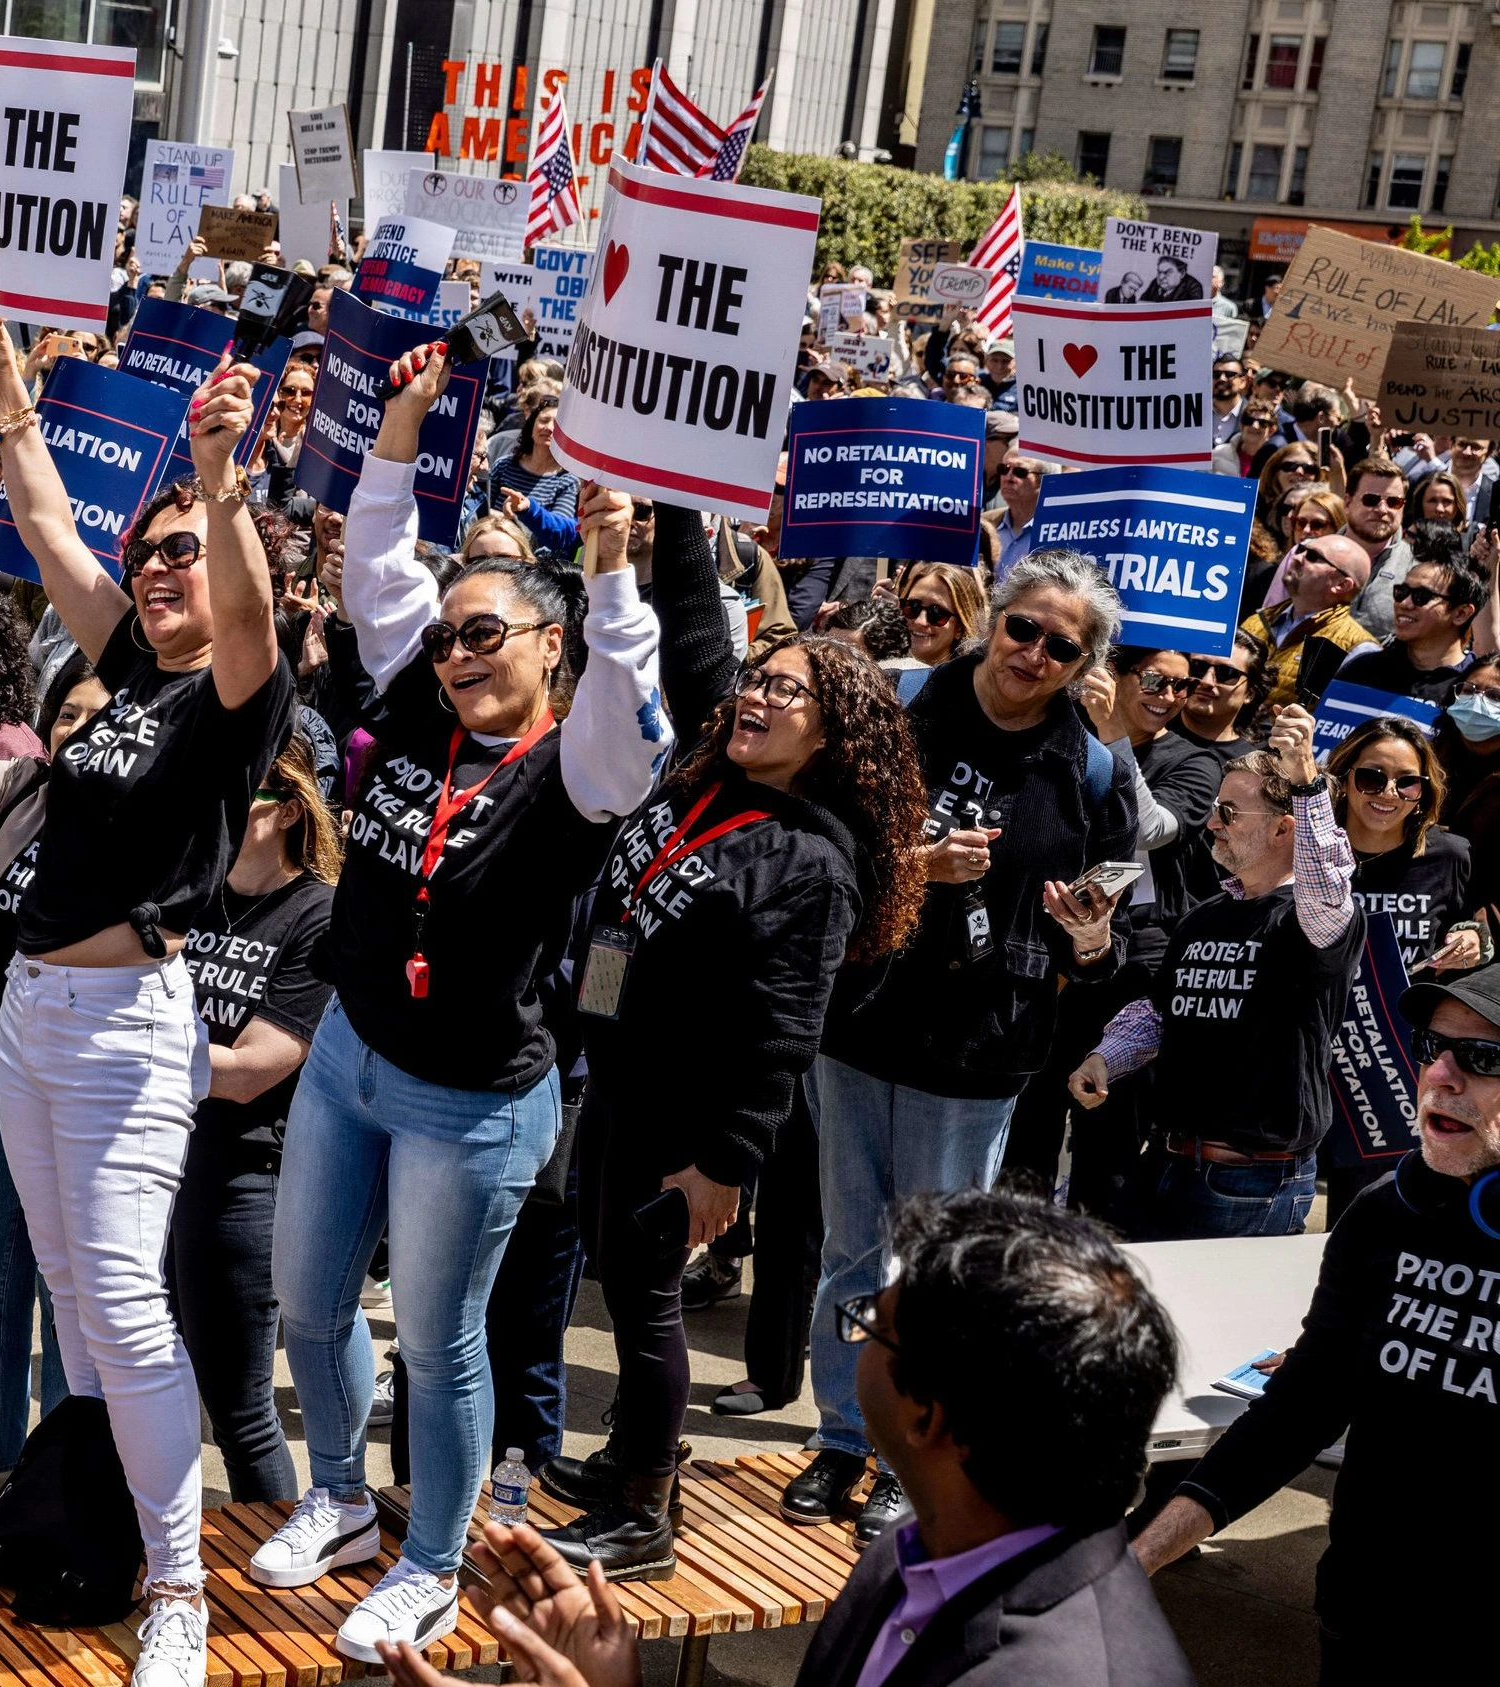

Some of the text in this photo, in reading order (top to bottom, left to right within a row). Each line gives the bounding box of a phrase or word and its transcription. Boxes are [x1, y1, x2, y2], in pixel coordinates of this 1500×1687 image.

[442, 59, 651, 113] THIS IS
[4, 107, 80, 173] THE
[424, 112, 644, 165] AMEICA
[157, 145, 224, 167] STAND UP
[150, 182, 214, 208] RULE
[454, 179, 485, 200] OUR
[166, 208, 186, 225] OF
[211, 209, 273, 227] MAKE AMERICA
[150, 222, 195, 245] LA
[374, 224, 406, 241] DEFEND
[1116, 222, 1202, 246] DON'T BEND
[219, 246, 246, 257] AGAIN
[373, 241, 418, 264] JUSTICE
[536, 248, 587, 274] GOVT
[908, 243, 950, 264] SEE
[1120, 237, 1195, 260] THE KNEE!
[360, 259, 388, 275] DEFEND
[1034, 255, 1101, 275] Make Lyi
[360, 276, 426, 305] DEMOCRACY
[656, 253, 748, 336] THE
[909, 285, 929, 298] IN
[940, 275, 981, 292] TRUMP
[1033, 273, 1099, 295] WRON
[1303, 256, 1373, 303] RULE
[1375, 288, 1414, 312] OF
[539, 297, 577, 321] THE
[1038, 338, 1177, 381] I THE
[1279, 321, 1381, 372] RULE of
[127, 349, 146, 369] NO
[143, 352, 214, 387] RETALIAT
[327, 352, 340, 379] NO
[1426, 354, 1457, 371] RULE
[1386, 381, 1427, 397] BEND
[347, 398, 380, 430] FOR
[1023, 386, 1203, 430] CONSTITUTION
[44, 422, 142, 472] LIATION
[803, 445, 967, 470] NO RETALIATION
[860, 468, 903, 486] FOR
[795, 492, 969, 516] REPRESENTATION
[1039, 517, 1120, 543] FEARLESS
[1124, 518, 1219, 548] LAWYERS
[1105, 551, 1229, 602] TRIALS
[351, 812, 380, 847] OF
[396, 808, 476, 849] RUE
[184, 928, 279, 965] ROTECT
[198, 962, 268, 1001] RULE
[1175, 967, 1256, 991] THE RULE
[201, 1000, 248, 1029] AW
[1171, 995, 1244, 1019] OF LAW
[1342, 1020, 1372, 1069] FOR
[1386, 1293, 1459, 1342] THE
[1379, 1340, 1437, 1380] OF
